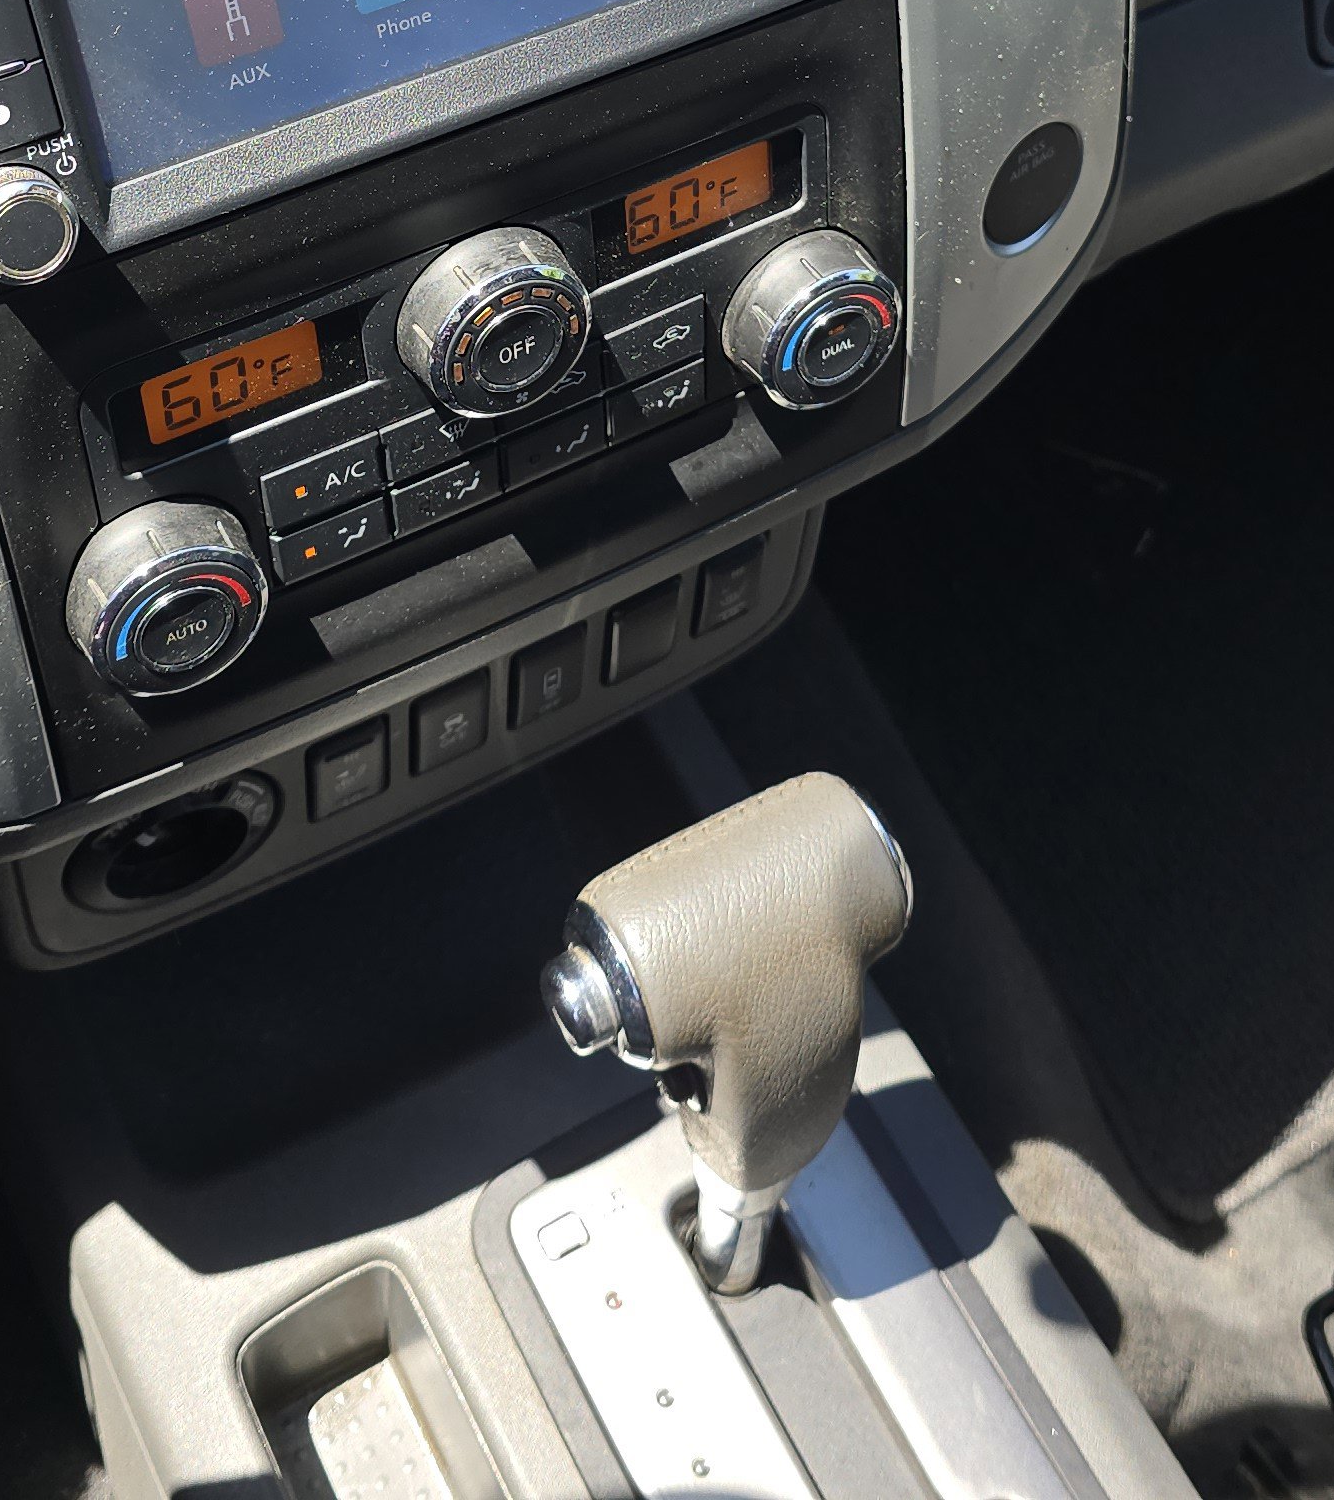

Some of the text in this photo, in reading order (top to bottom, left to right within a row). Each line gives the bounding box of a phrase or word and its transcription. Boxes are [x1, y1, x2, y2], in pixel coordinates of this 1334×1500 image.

[376, 9, 433, 39] Phone
[229, 62, 271, 91] AUX
[26, 132, 74, 161] PUSH
[1017, 140, 1046, 164] PASS
[1009, 162, 1030, 183] AIR
[498, 335, 536, 364] OFF
[821, 337, 856, 360] DUAL
[324, 460, 367, 491] A/C
[166, 619, 208, 646] AUTO
